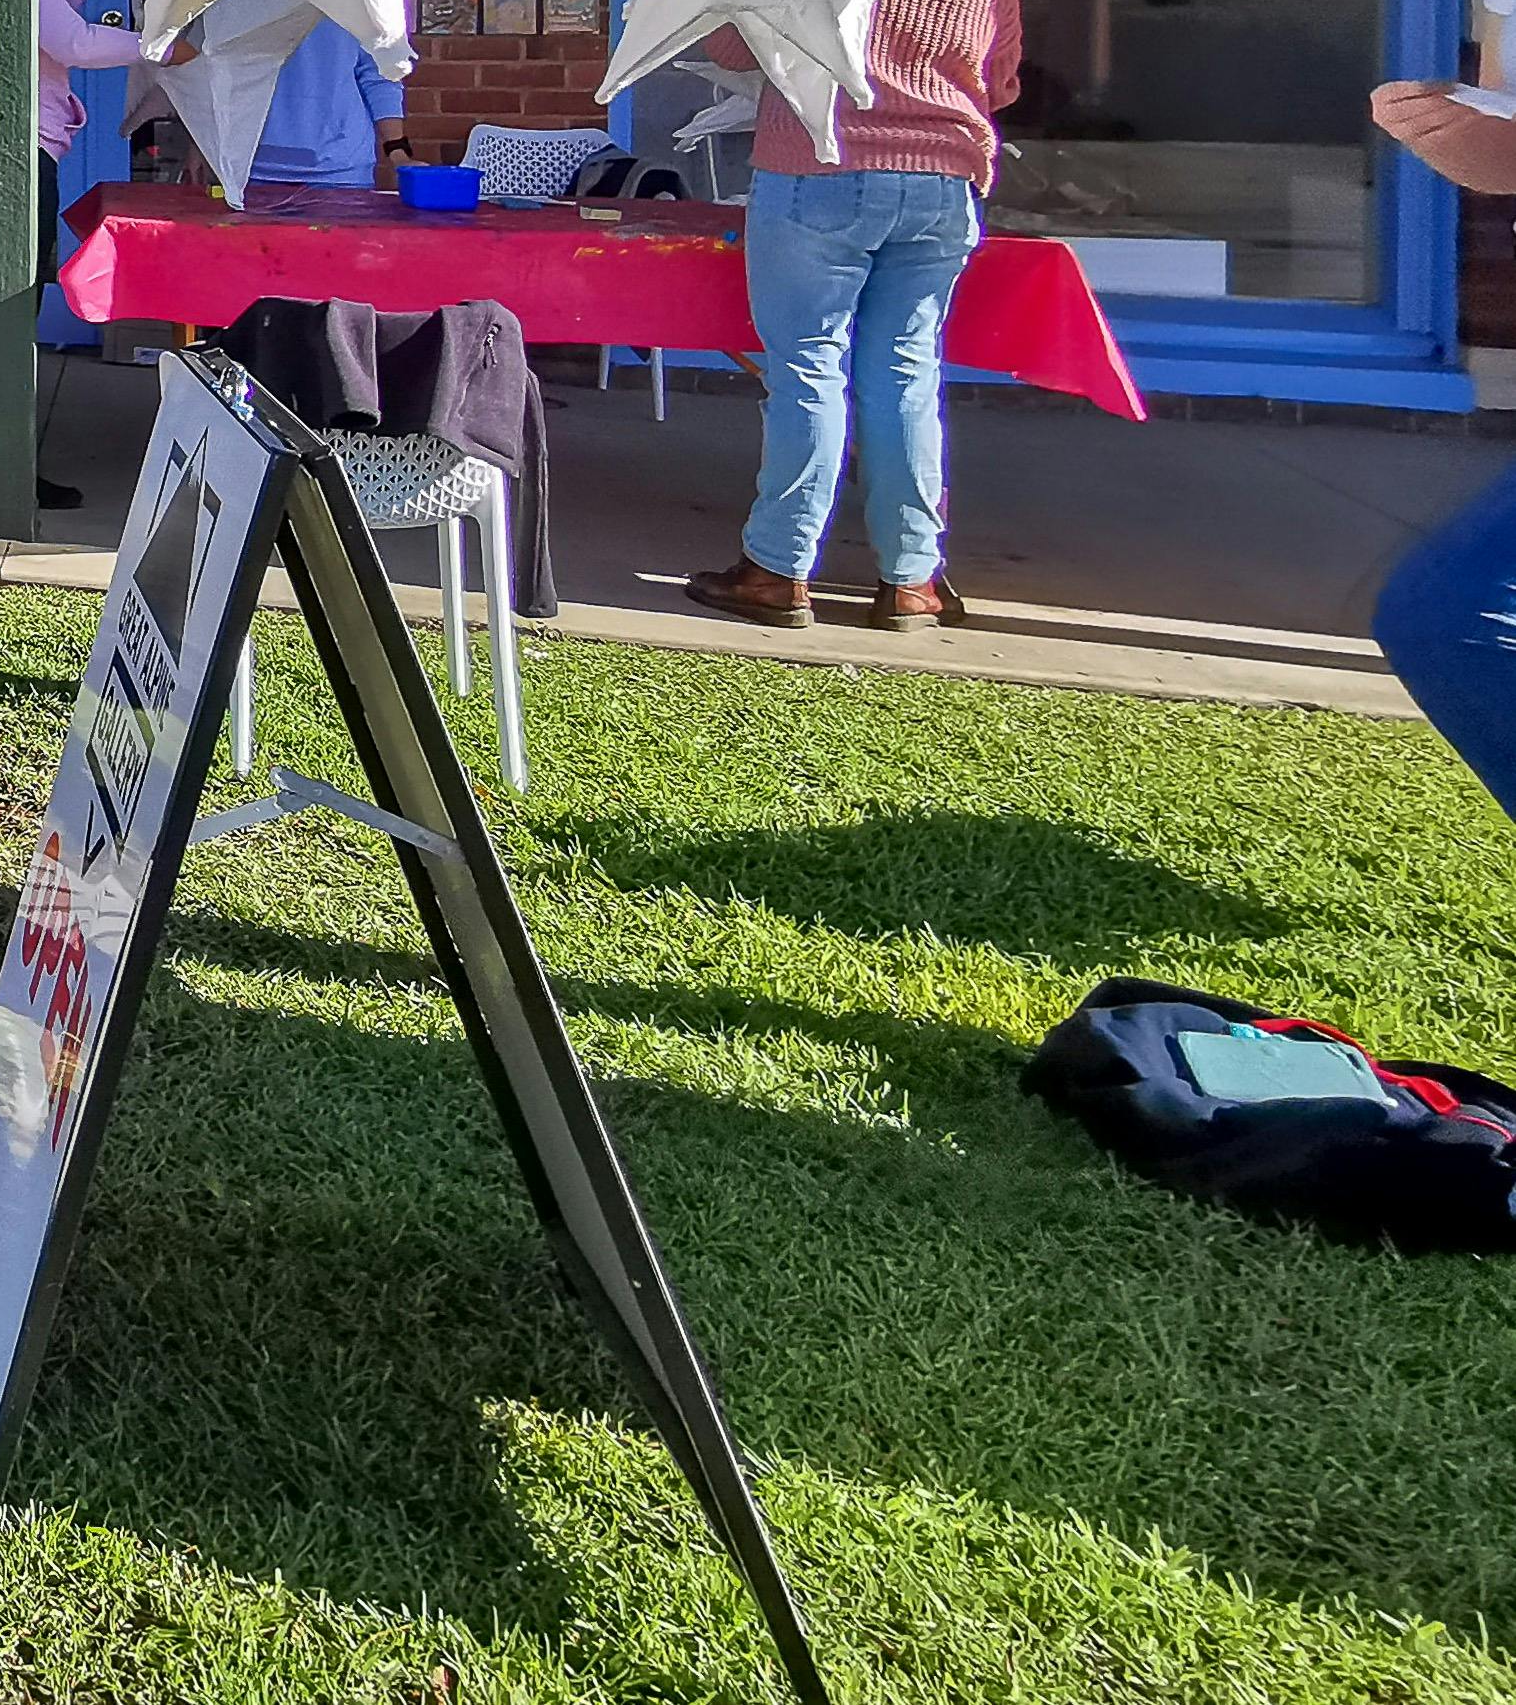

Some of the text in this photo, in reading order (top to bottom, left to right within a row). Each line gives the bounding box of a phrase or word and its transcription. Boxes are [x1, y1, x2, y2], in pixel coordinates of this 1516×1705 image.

[118, 587, 176, 733] GREAT ALPINE
[97, 684, 144, 815] GALLERY
[21, 829, 93, 1155] OPEN
